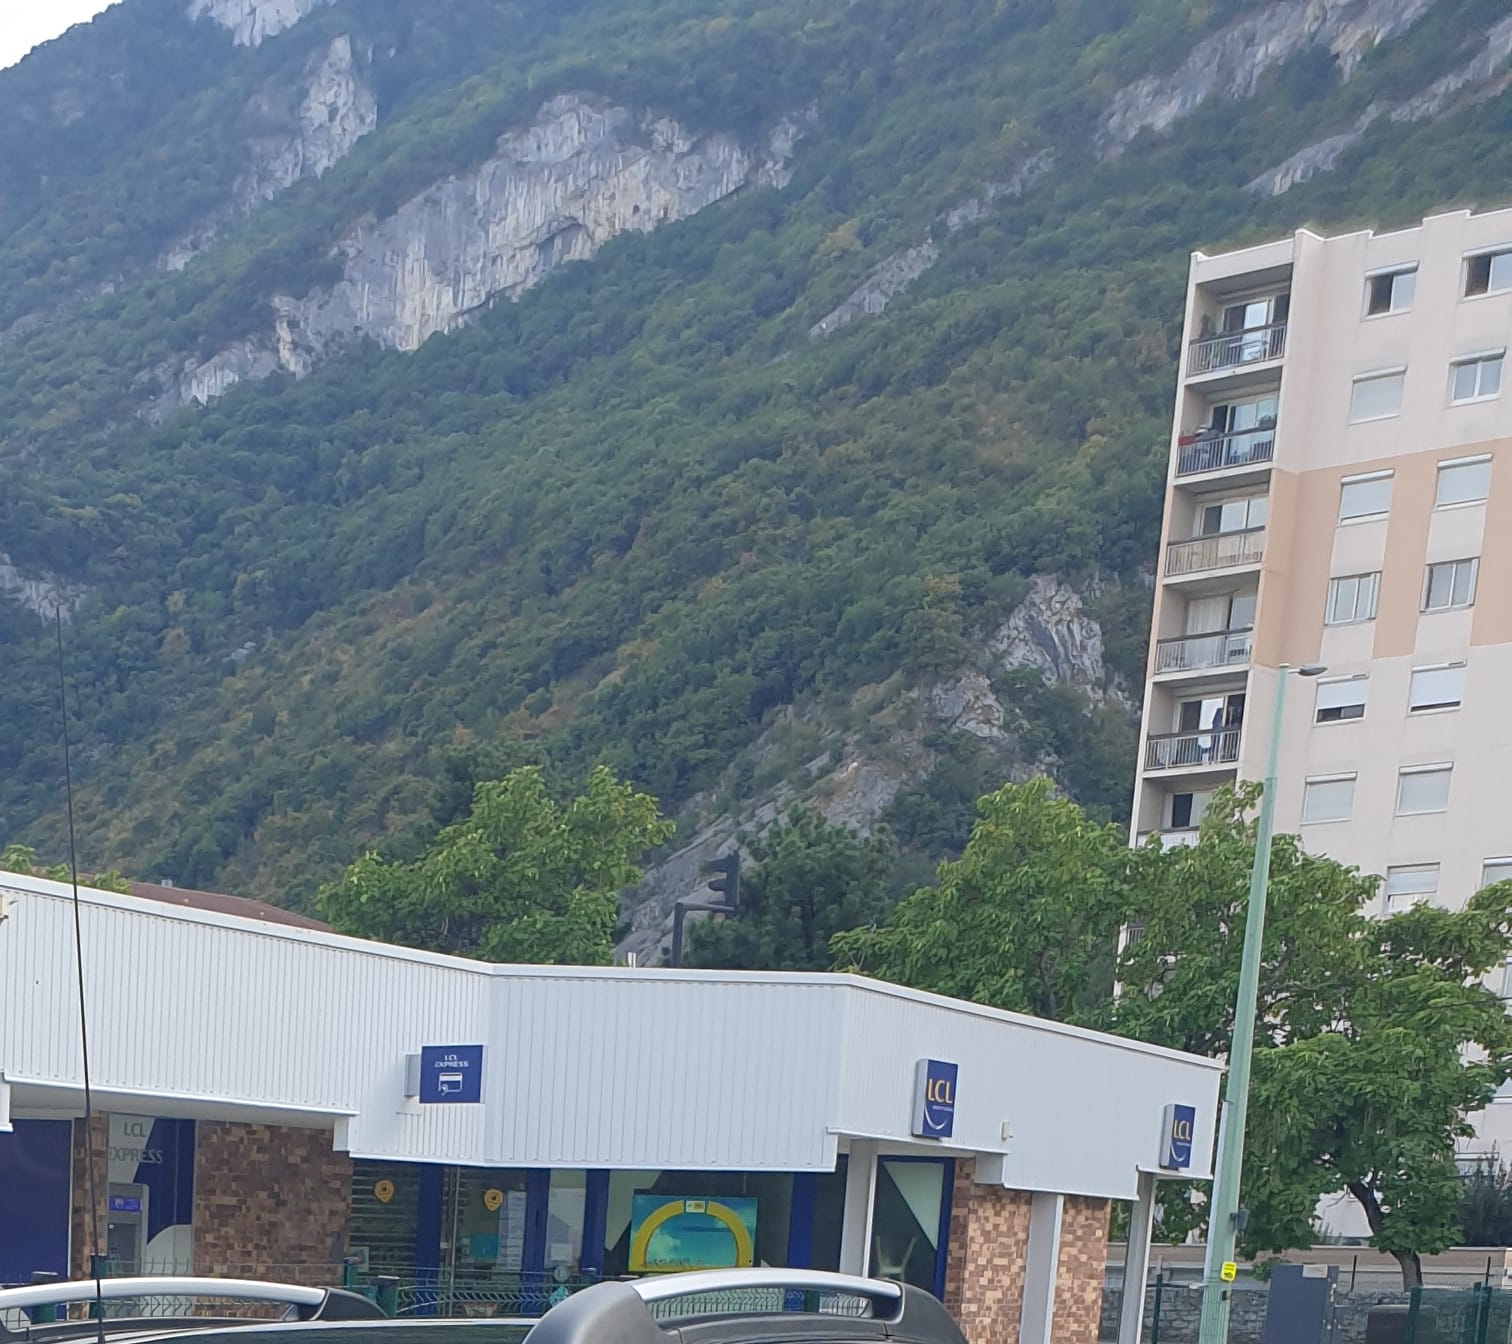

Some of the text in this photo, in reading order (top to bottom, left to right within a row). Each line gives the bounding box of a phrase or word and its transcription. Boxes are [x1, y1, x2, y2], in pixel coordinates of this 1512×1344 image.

[928, 1077, 953, 1104] LCL
[123, 1121, 147, 1138] LCL
[1173, 1120, 1191, 1141] LCL
